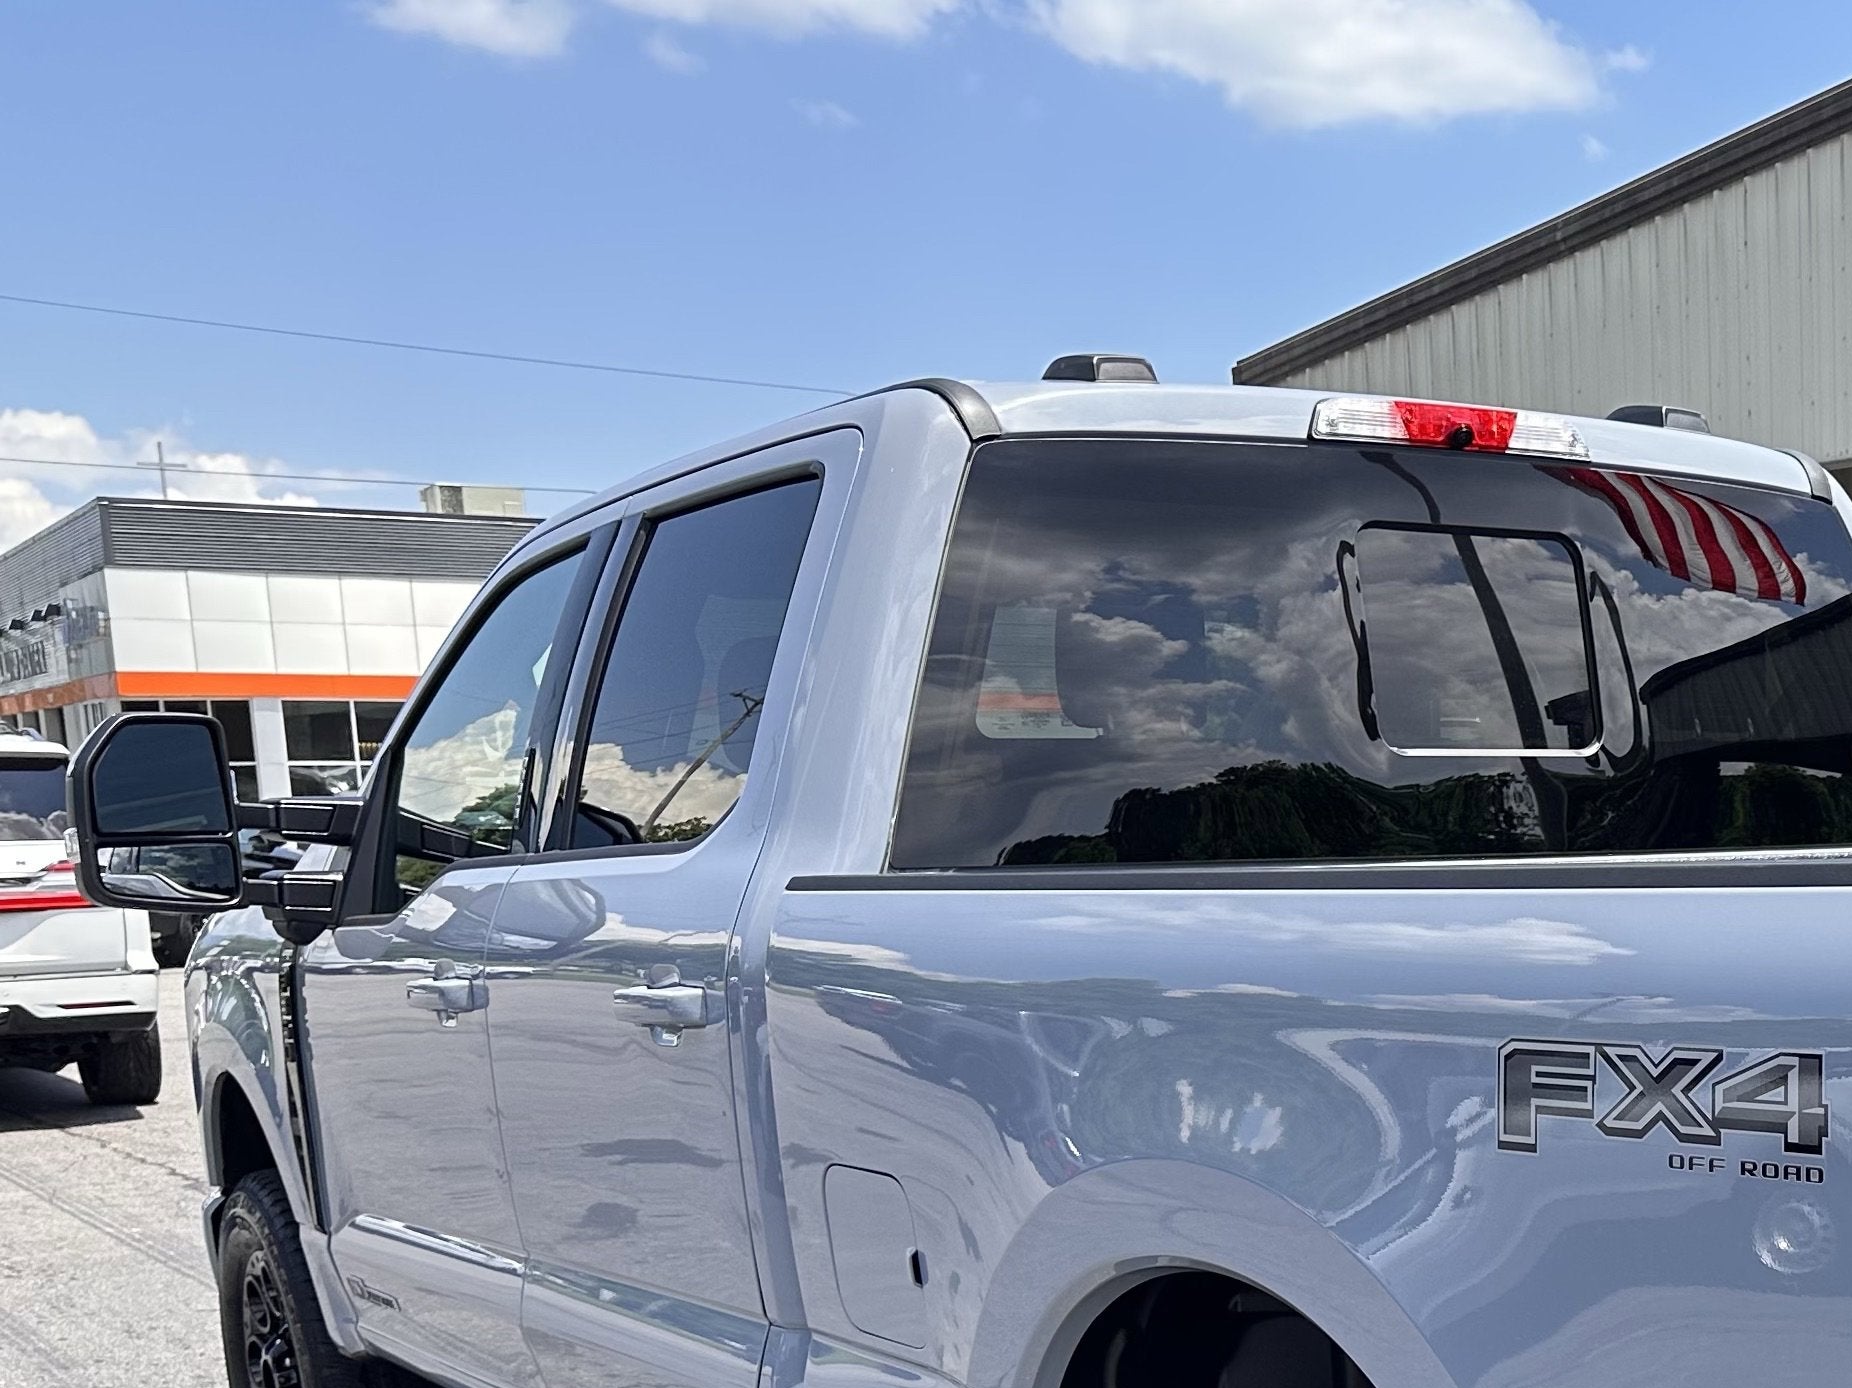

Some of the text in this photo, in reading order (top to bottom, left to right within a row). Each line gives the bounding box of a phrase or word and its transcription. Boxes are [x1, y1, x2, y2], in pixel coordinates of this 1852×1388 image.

[1496, 1037, 1830, 1155] FX4
[1667, 1152, 1825, 1184] OFF ROAD
